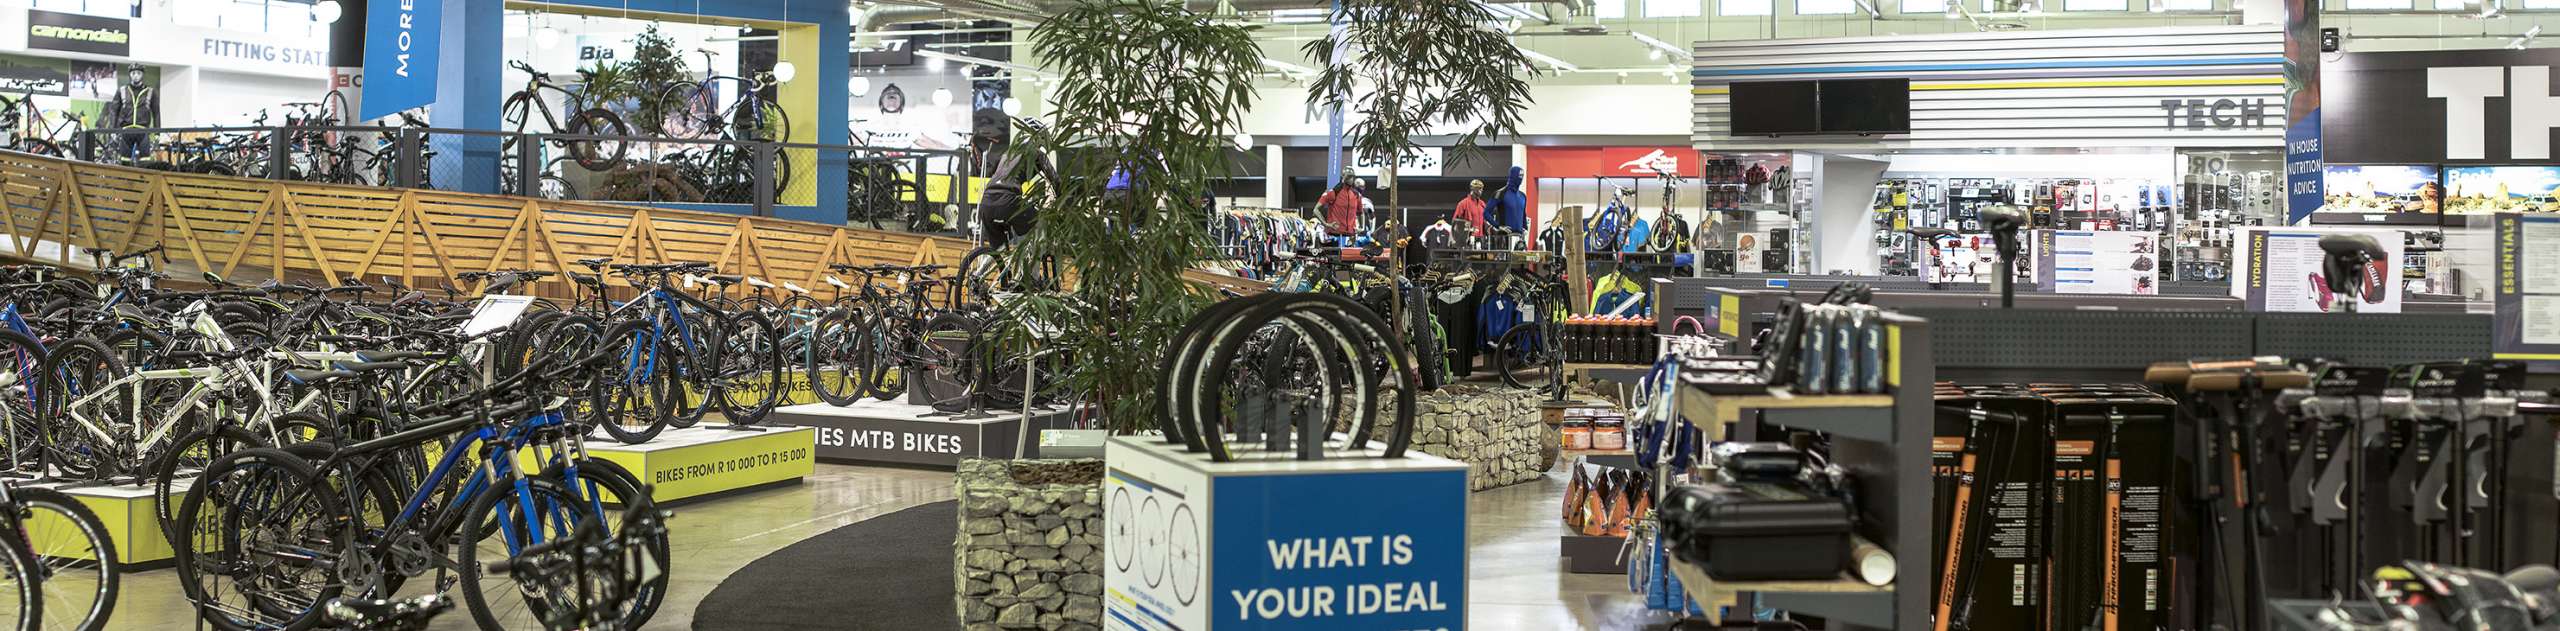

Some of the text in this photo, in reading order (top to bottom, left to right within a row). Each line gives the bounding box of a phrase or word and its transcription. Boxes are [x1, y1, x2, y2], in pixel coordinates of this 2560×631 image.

[31, 24, 128, 44] cannondale
[396, 0, 413, 77] MORE
[204, 38, 276, 62] FITTING
[2161, 98, 2264, 131] TECH
[2289, 138, 2318, 155] IN HOUSE
[2288, 159, 2321, 175] NUTRITION
[2293, 180, 2316, 195] ADVICE
[2252, 234, 2263, 288] HYDRATION
[2502, 218, 2514, 294] ESSENTIALS
[780, 381, 812, 393] BKES
[850, 429, 895, 450] MTB
[903, 432, 962, 454] BIKES
[656, 448, 807, 484] BIKES FROM R 10 000 TO R 15 000
[1267, 534, 1413, 570] WHAT IS
[1231, 581, 1447, 620] YOUR IDEAL
